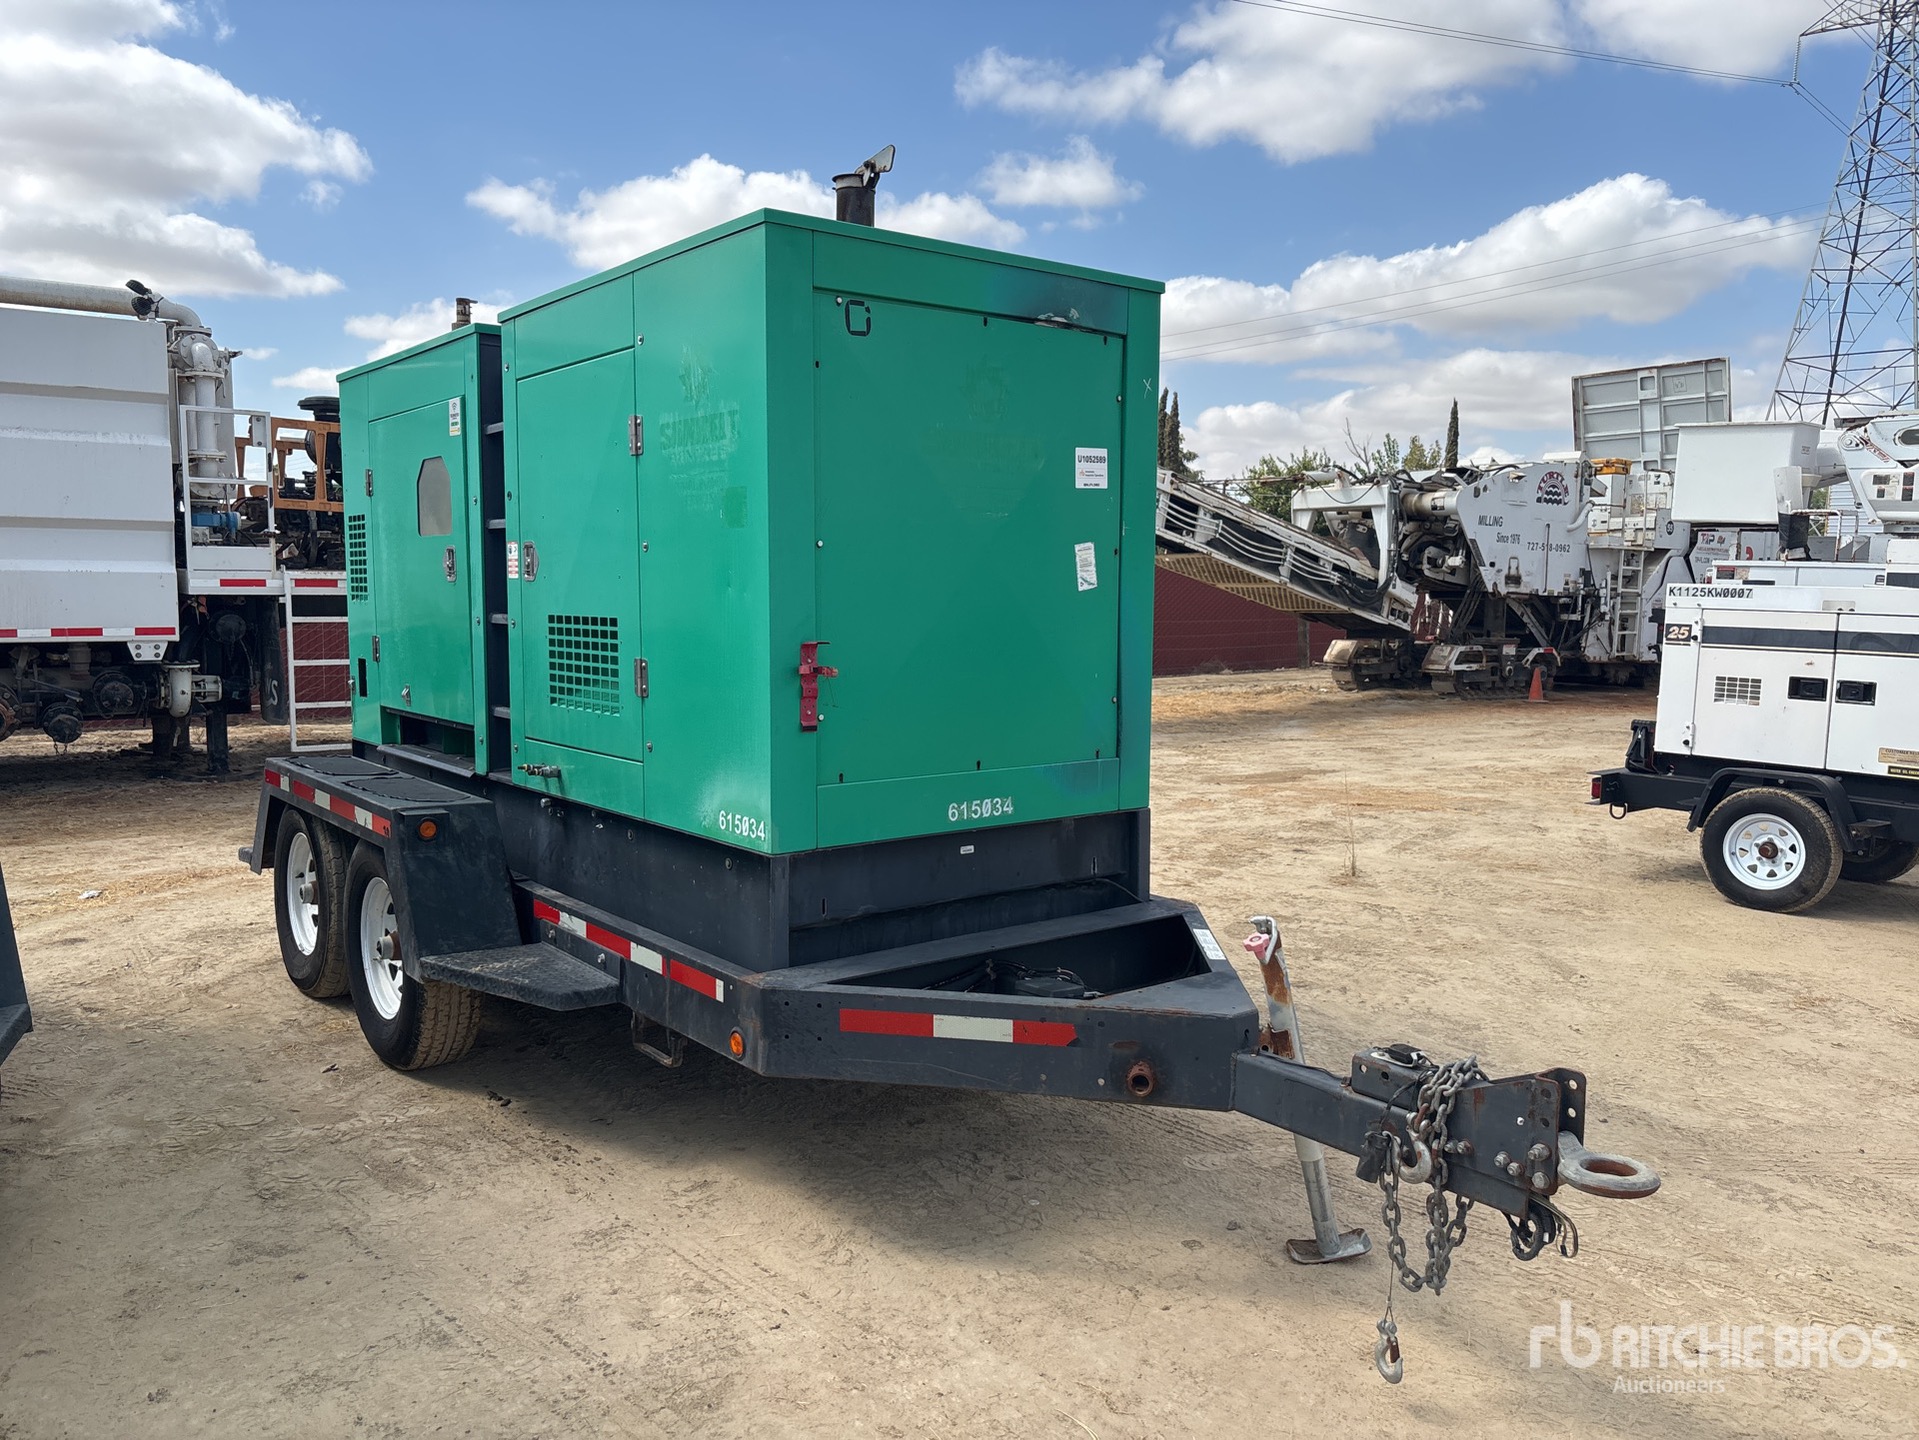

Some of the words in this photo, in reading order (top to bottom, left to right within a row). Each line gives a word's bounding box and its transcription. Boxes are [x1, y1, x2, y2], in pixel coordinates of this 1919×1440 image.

[1478, 515, 1503, 527] MILLING
[1496, 532, 1510, 543] Since
[1668, 586, 1753, 599] K1125KW0007
[1667, 625, 1690, 639] 25
